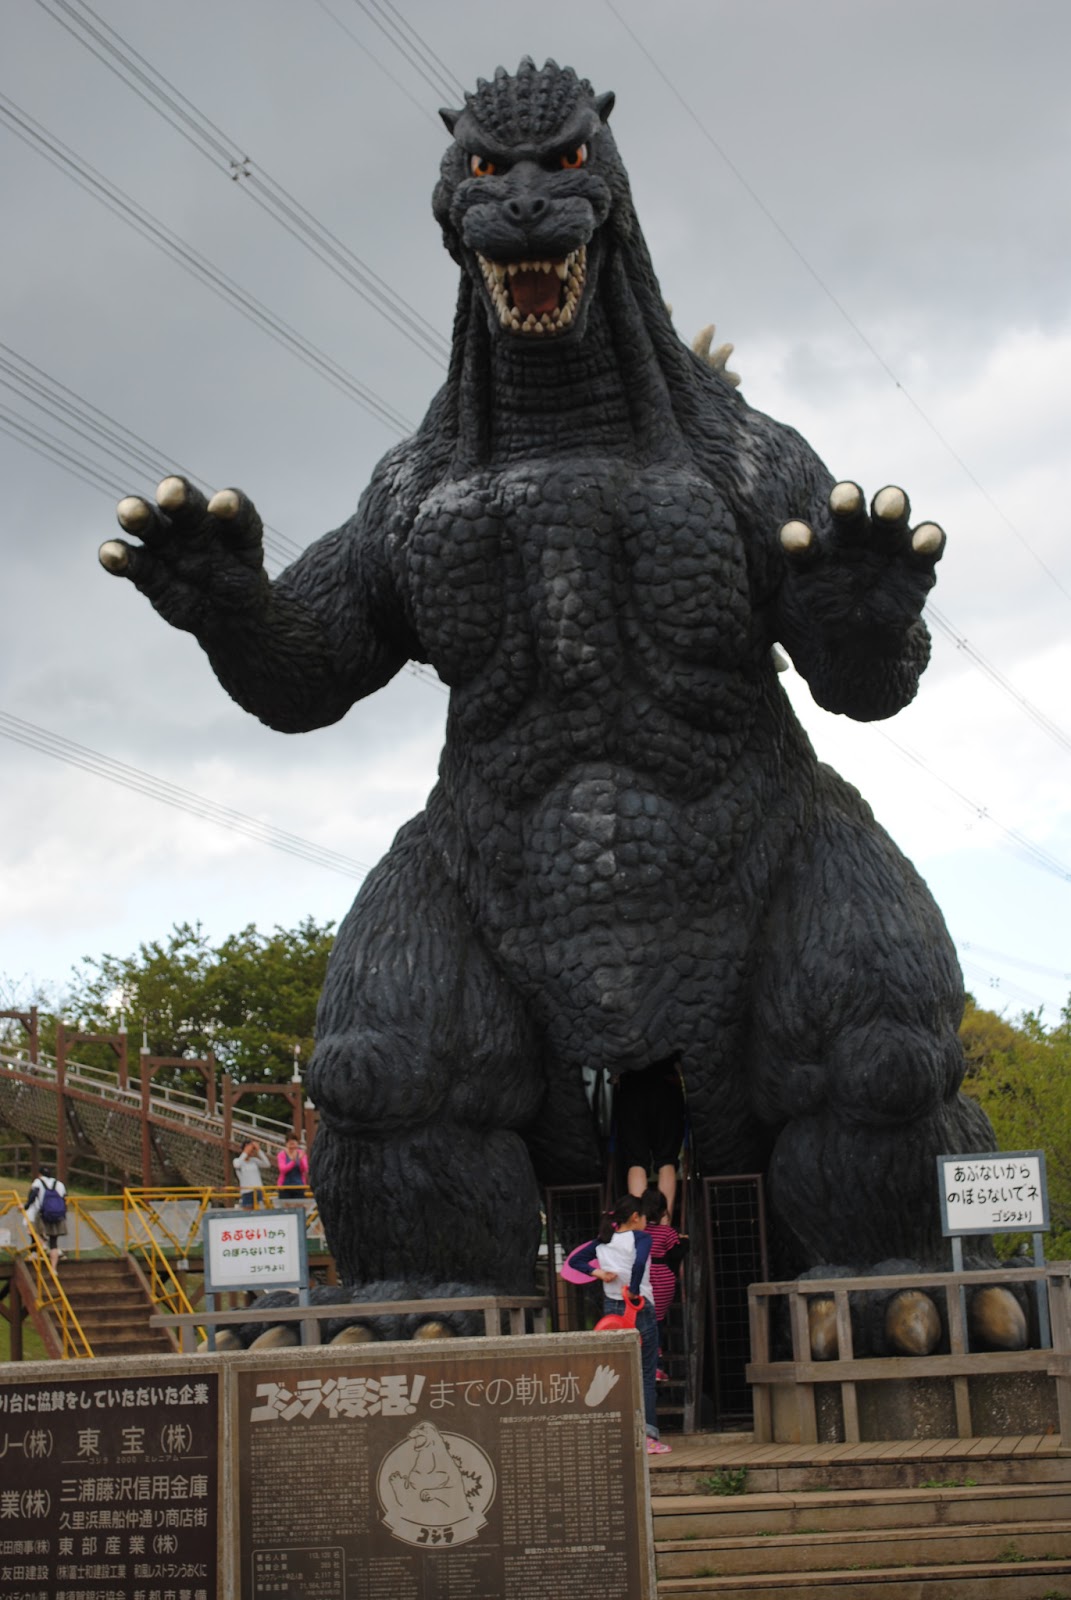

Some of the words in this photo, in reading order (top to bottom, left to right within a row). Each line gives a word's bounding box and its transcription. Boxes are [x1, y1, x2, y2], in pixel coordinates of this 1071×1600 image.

[954, 1163, 1031, 1183] あぶないから
[992, 1210, 1032, 1223] ゴジラより
[221, 1228, 286, 1242] あぶないから
[430, 1371, 581, 1409] までの軌跡
[60, 1474, 209, 1502] 三浦藤沢信用金庫
[59, 1508, 208, 1530] 久里浜黒船仲通り商店街
[416, 1526, 454, 1545] ゴジラ
